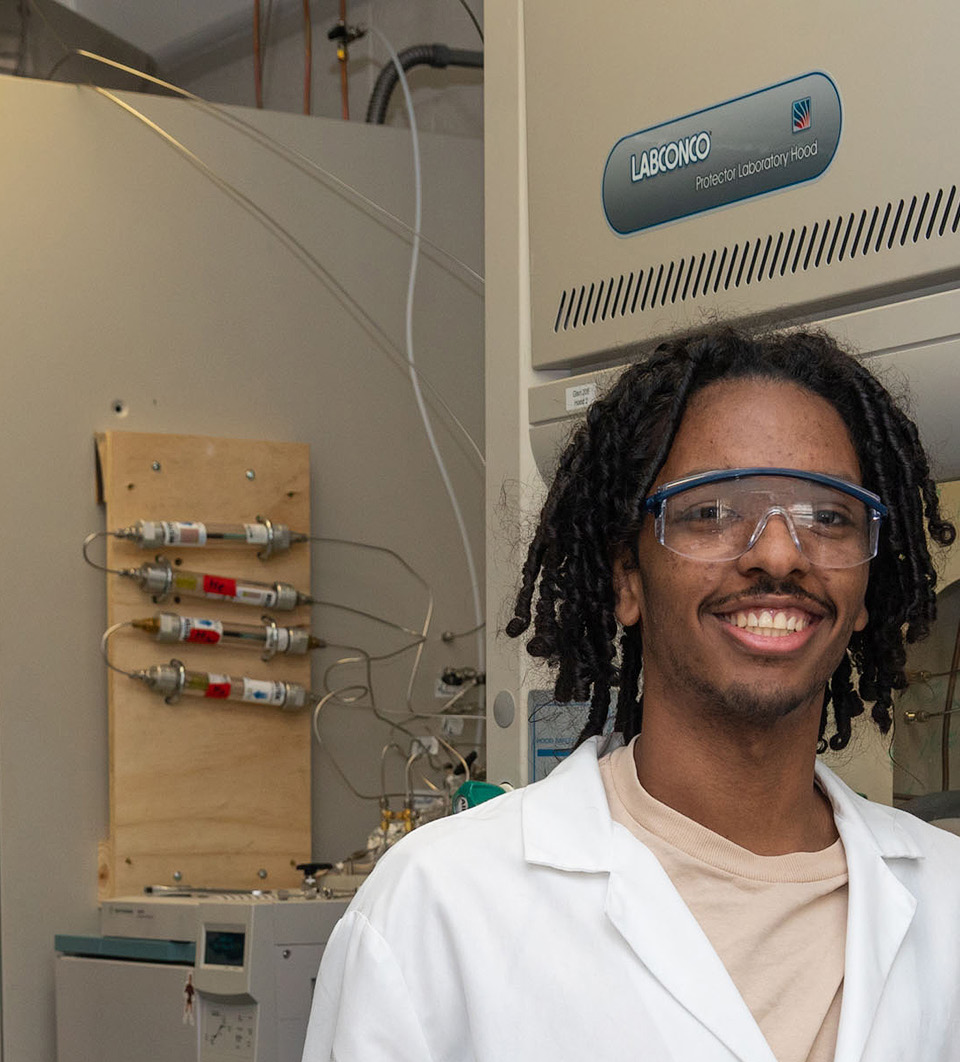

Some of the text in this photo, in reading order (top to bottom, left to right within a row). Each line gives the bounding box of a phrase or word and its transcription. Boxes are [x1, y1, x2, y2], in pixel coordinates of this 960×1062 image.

[631, 131, 712, 182] LABCONCO
[695, 140, 818, 190] Protector Laboratory Hood
